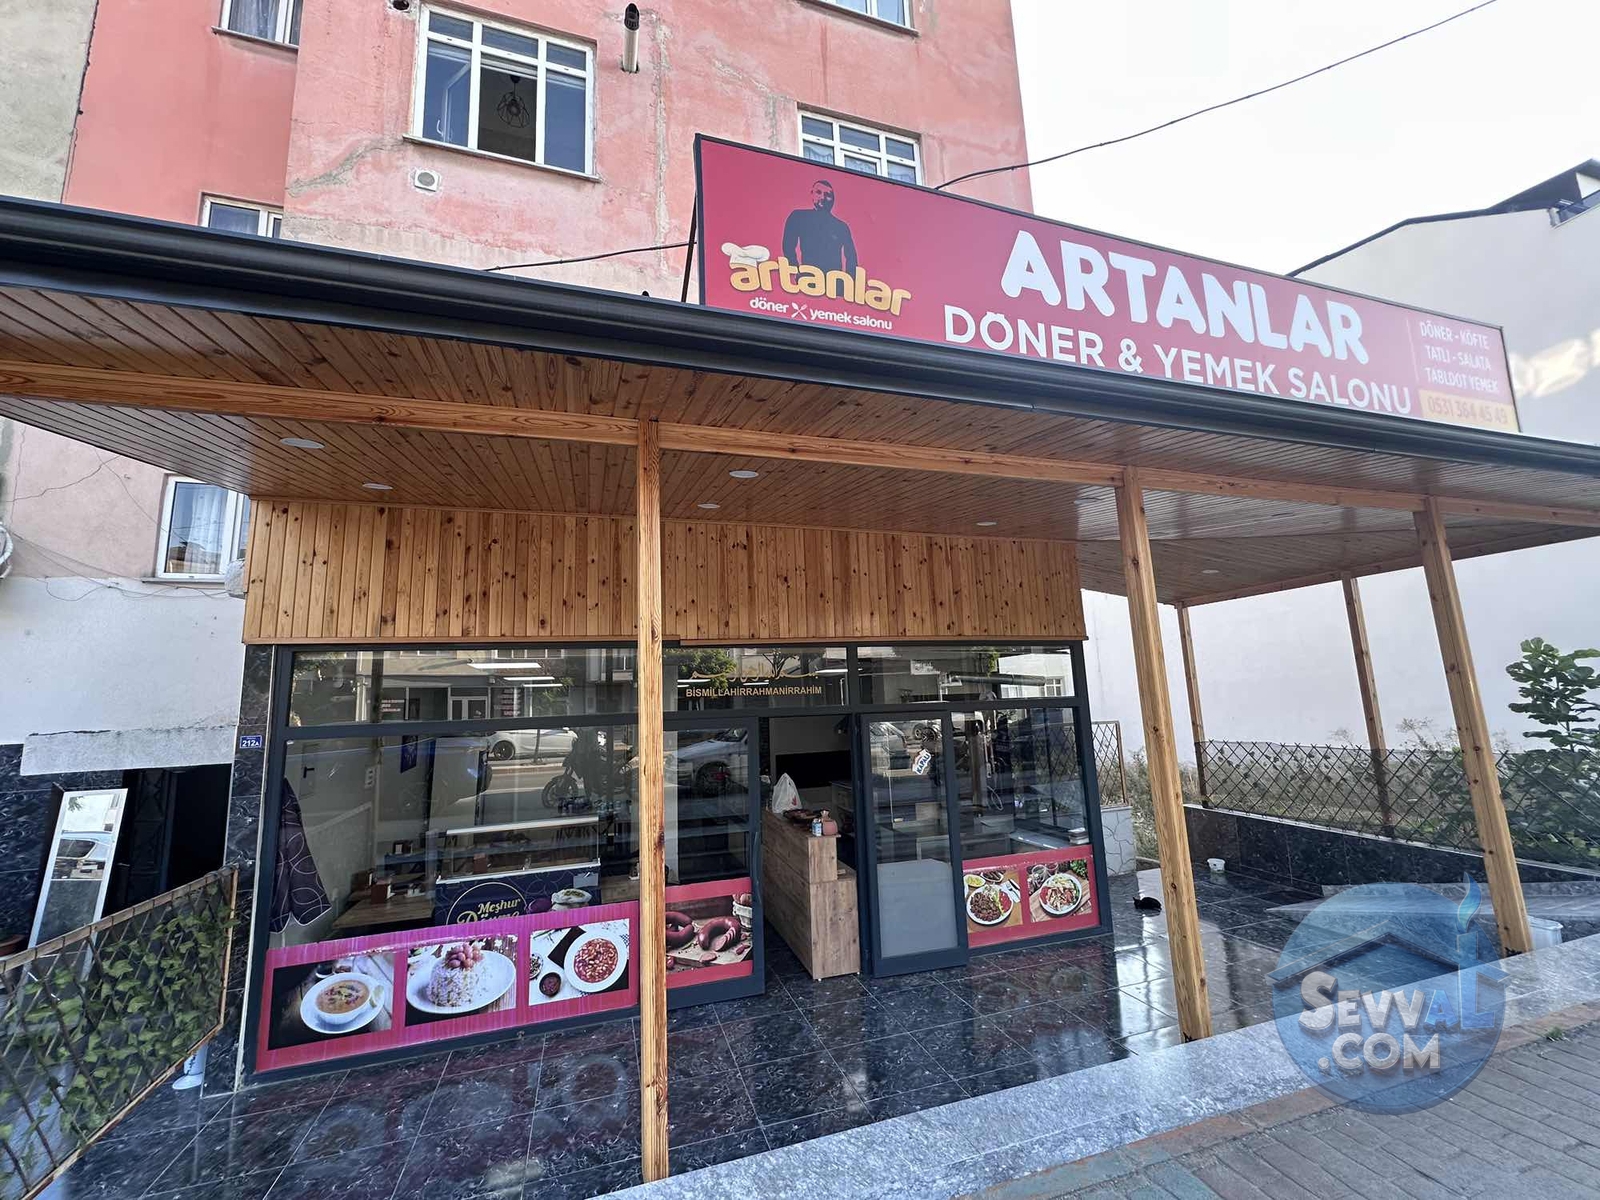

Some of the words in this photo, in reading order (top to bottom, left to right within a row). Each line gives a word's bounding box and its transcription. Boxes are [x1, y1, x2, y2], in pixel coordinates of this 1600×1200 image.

[729, 256, 911, 316] artanlar
[1001, 230, 1369, 365] ARTANLAR
[749, 296, 789, 314] döner
[809, 309, 851, 324] yemek
[853, 315, 892, 330] salonu
[1419, 320, 1453, 342] DÖNER
[1460, 329, 1490, 350] KÖFTE
[944, 304, 1105, 367] DÖNER
[1118, 338, 1144, 374] &
[1153, 344, 1280, 395] YEMEK
[1288, 367, 1412, 414] SALONU
[477, 899, 521, 915] Meşhur
